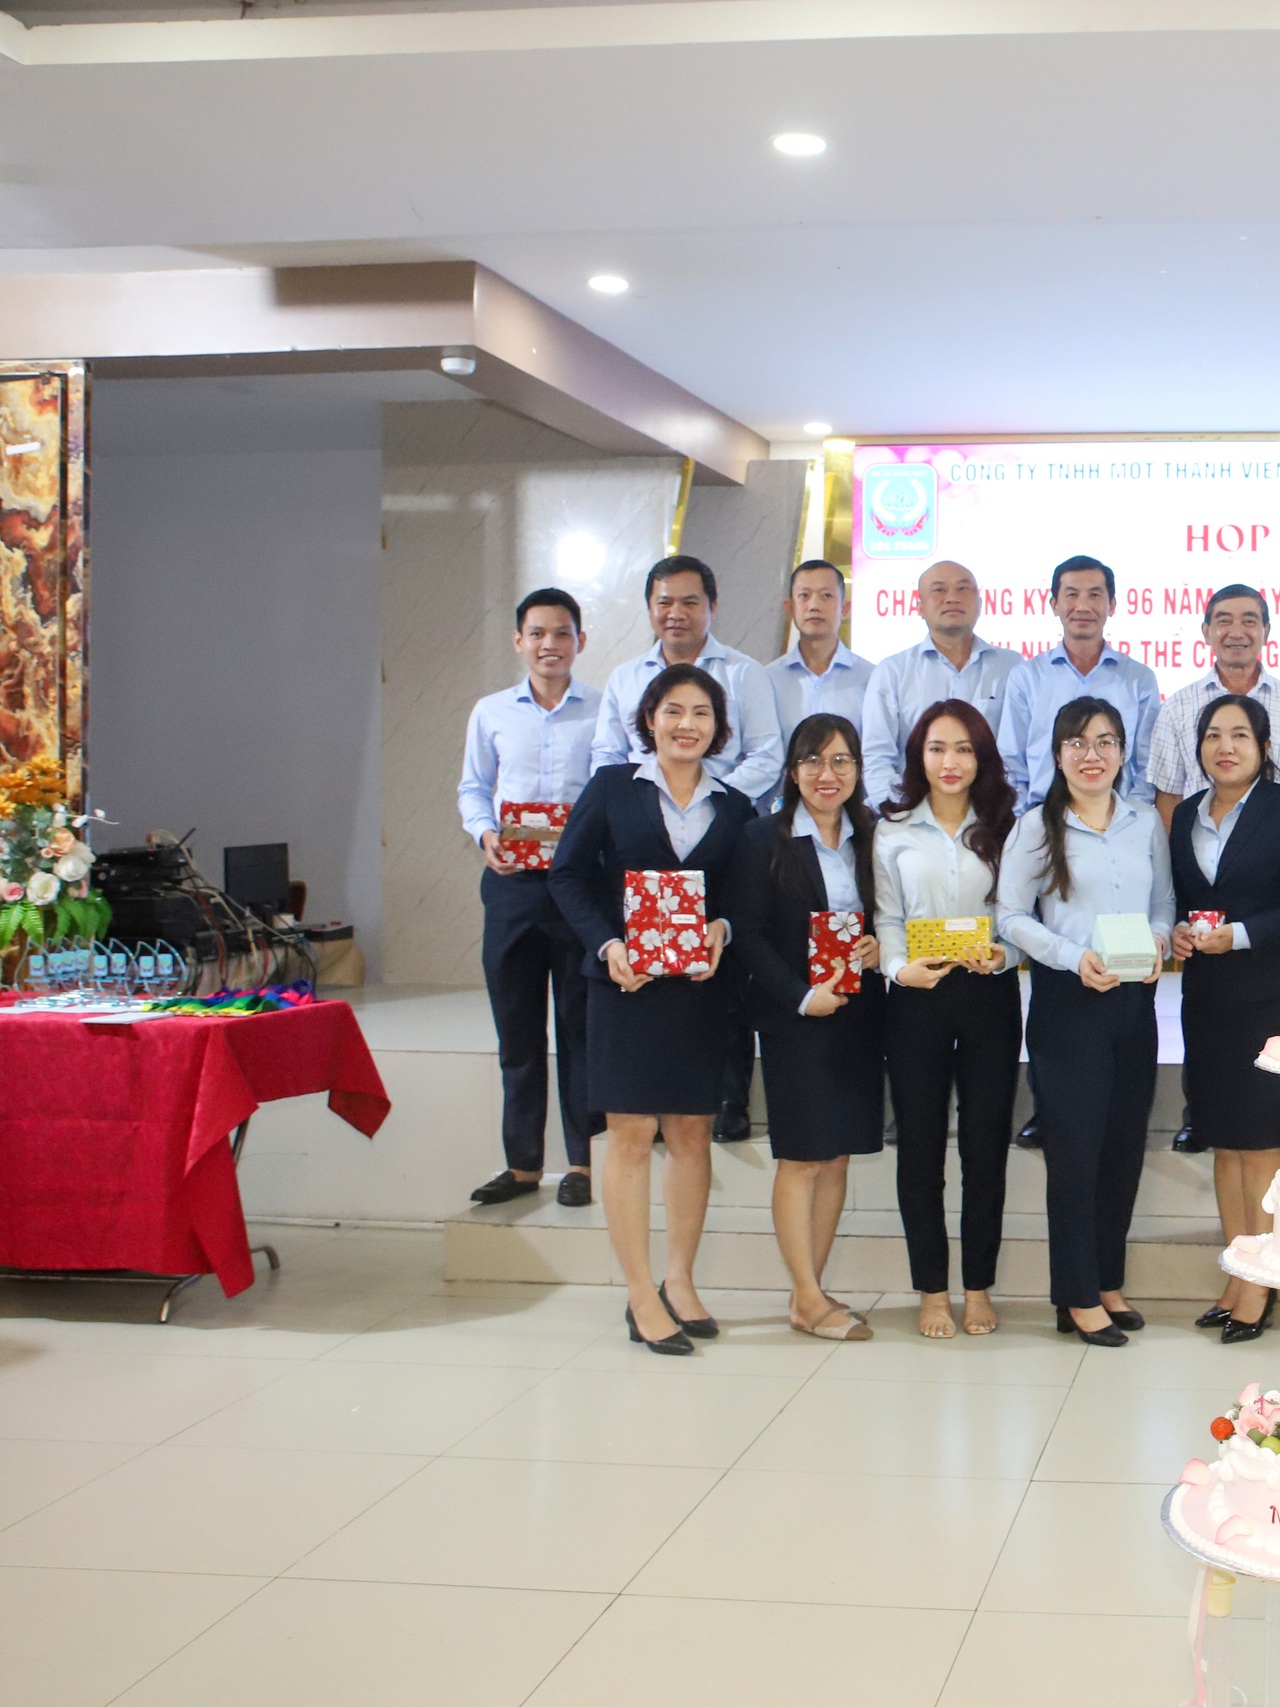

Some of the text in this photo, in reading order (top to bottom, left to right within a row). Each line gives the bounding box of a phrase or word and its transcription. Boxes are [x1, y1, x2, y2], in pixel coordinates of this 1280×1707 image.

[1016, 462, 1037, 480] TY
[1046, 462, 1100, 480] TNHH
[876, 582, 921, 616] CHÀ
[1127, 587, 1153, 615] 96
